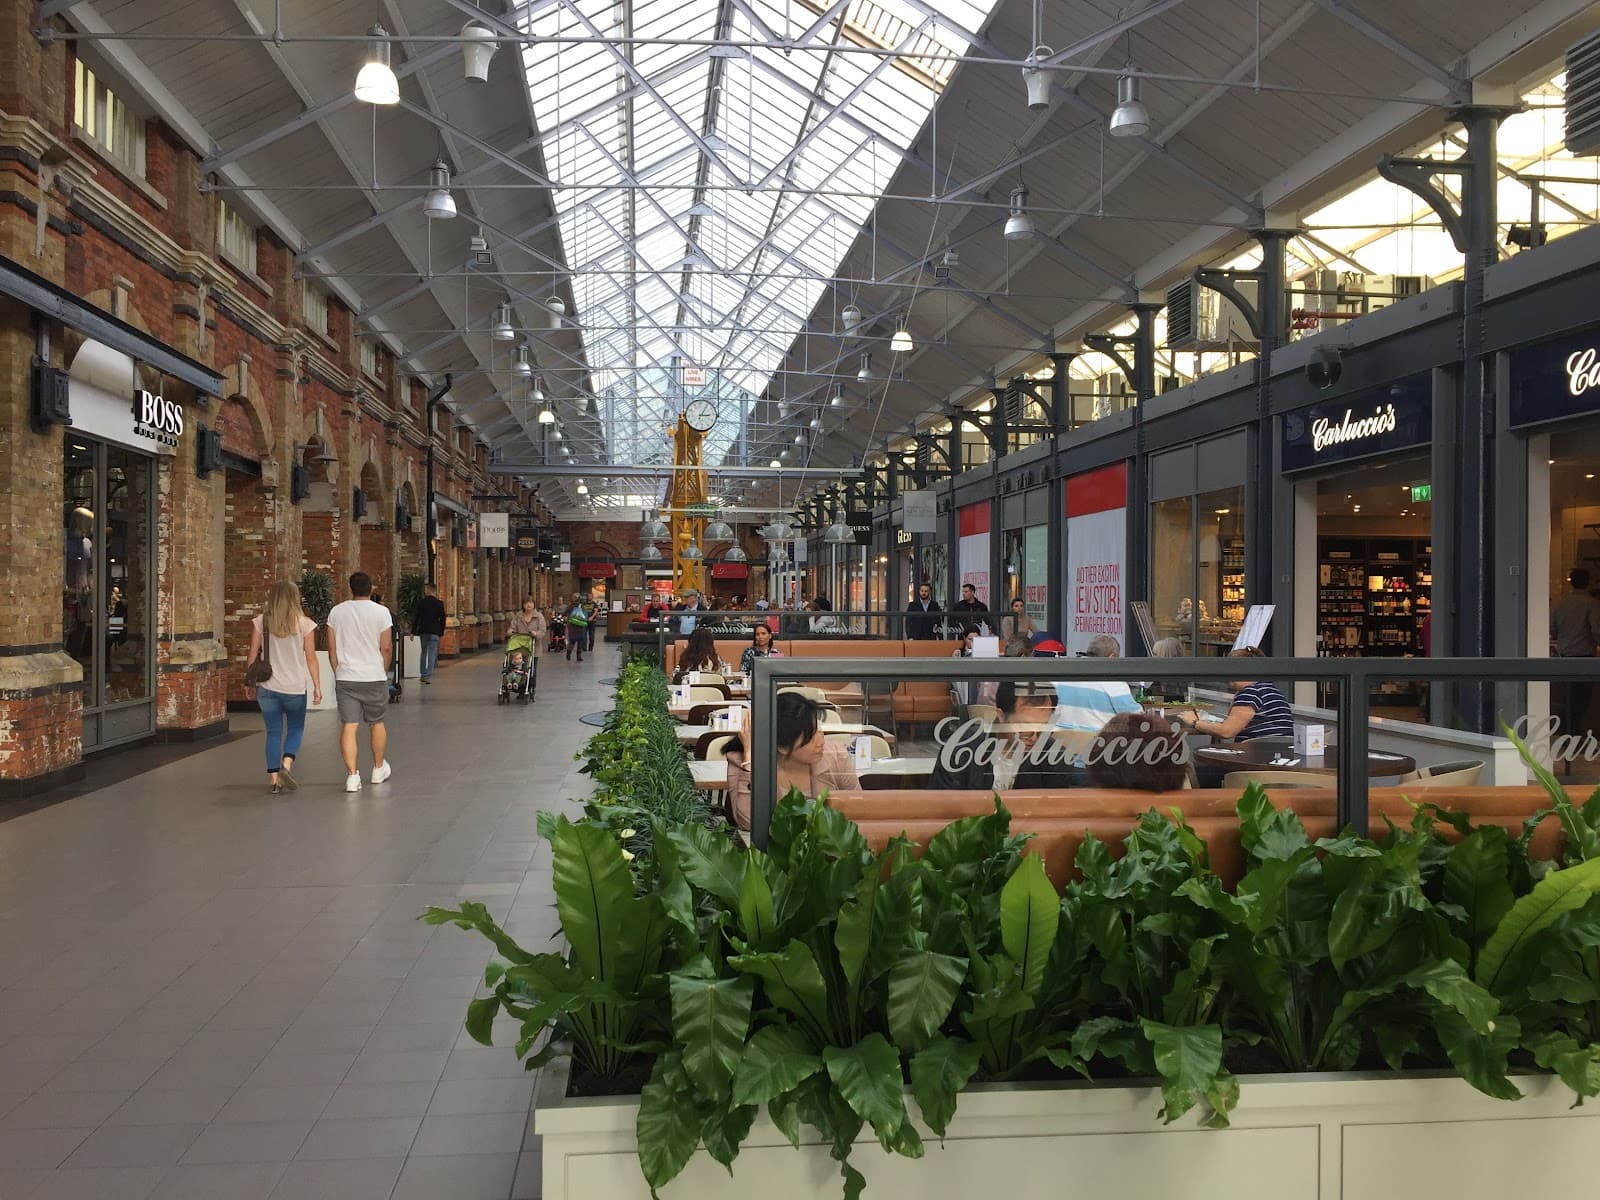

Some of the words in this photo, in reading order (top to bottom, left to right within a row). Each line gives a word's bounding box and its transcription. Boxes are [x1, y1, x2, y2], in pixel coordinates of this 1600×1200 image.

[142, 390, 184, 436] BOSS
[1312, 403, 1396, 452] Carluccio's
[933, 716, 1190, 772] Carluccio's
